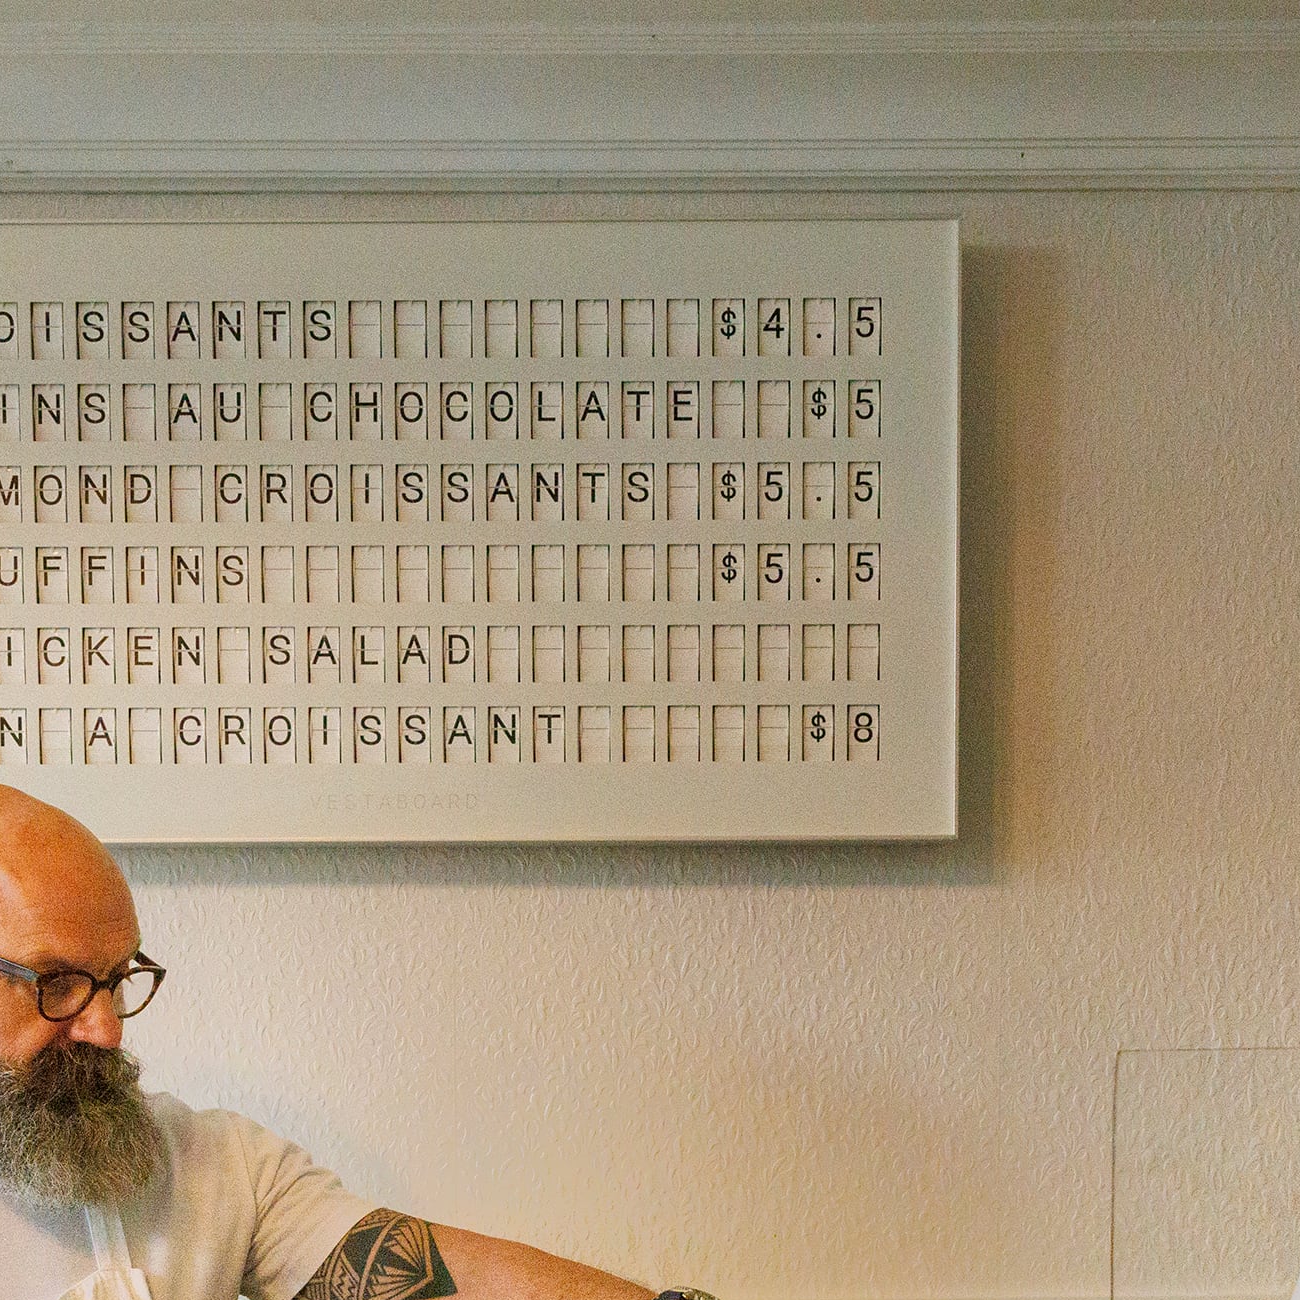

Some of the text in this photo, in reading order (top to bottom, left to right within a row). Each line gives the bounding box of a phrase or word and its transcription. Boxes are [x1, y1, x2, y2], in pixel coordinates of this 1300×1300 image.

[719, 304, 876, 341] $4.5
[171, 390, 243, 425] AU
[308, 388, 695, 424] CHOCOLATE
[809, 386, 875, 421] $5
[218, 470, 651, 506] CROISSANTS
[719, 469, 875, 504] $5.5
[719, 550, 876, 585] $5.5
[268, 632, 472, 668] SALAD
[87, 715, 115, 748] A
[178, 712, 563, 749] CROISSANT
[809, 710, 875, 745] $8
[309, 792, 479, 811] VESTABOARD
